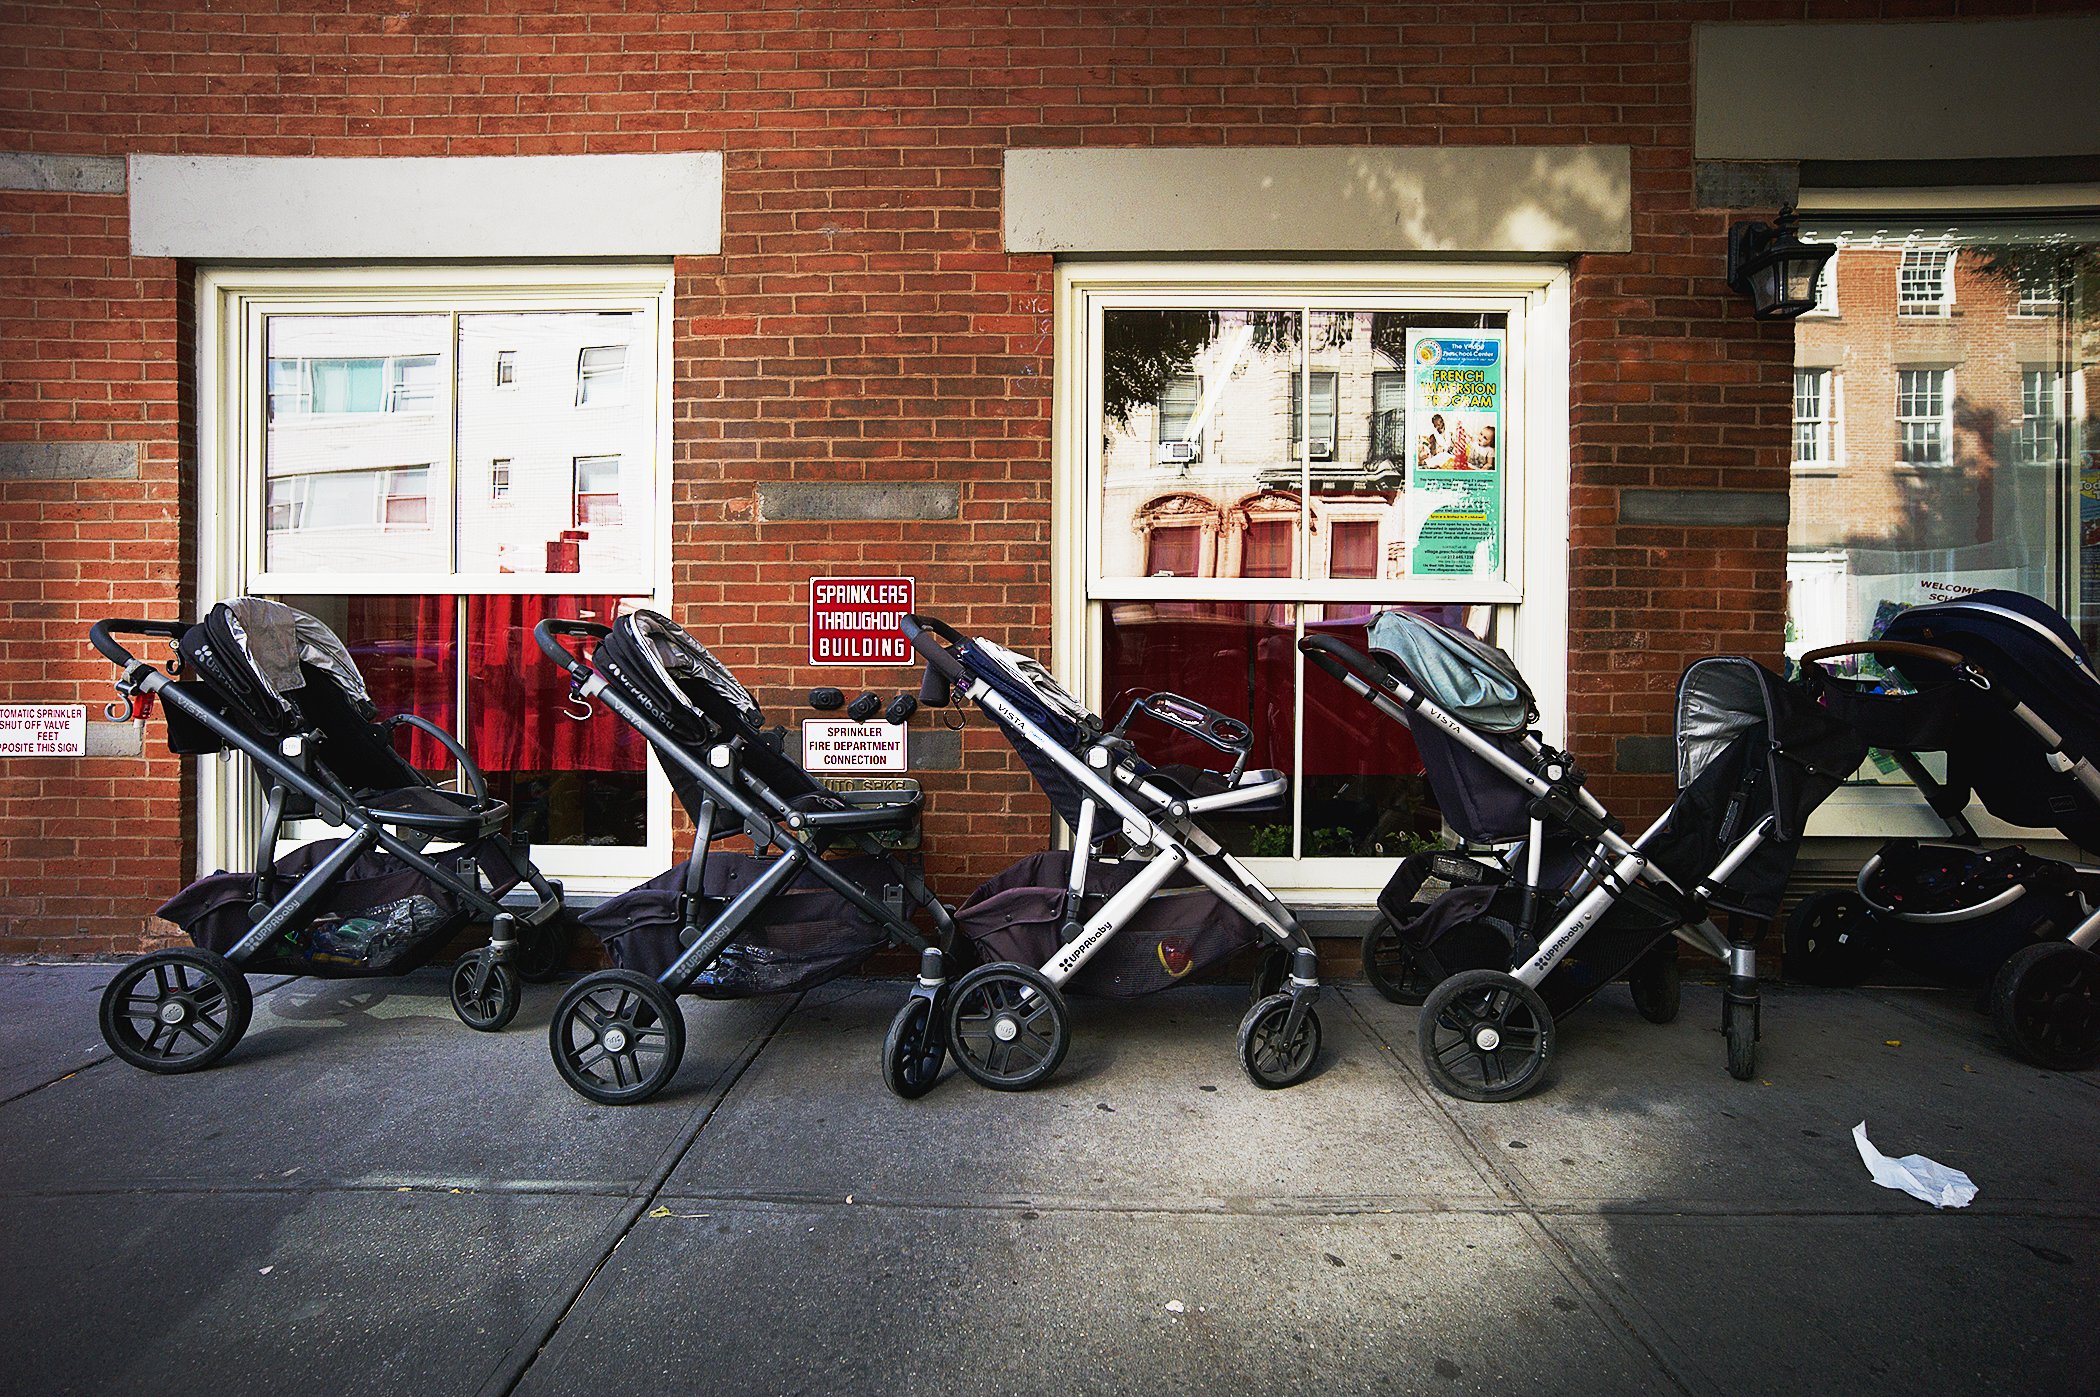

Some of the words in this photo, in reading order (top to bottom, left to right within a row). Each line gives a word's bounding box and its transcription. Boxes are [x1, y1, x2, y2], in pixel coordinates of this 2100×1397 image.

[1018, 297, 1049, 313] NYC
[1433, 370, 1485, 382] FRENCH
[1424, 394, 1493, 408] PROGRAM
[816, 584, 908, 604] SPRINKLERS
[1920, 580, 1980, 594] WELCOME
[819, 638, 905, 657] BUILDING
[36, 709, 82, 719] SPRINKLER
[177, 696, 209, 722] VISTA
[613, 700, 643, 729] VISTA
[998, 703, 1026, 730] VISTA
[1430, 707, 1460, 734] VISTA
[0, 720, 23, 730] SHUT
[24, 720, 42, 730] OFF
[44, 720, 70, 730] VALVE
[827, 727, 882, 737] SPRINKLER
[37, 731, 59, 741] FEET
[0, 743, 34, 752] POSITE
[36, 743, 56, 752] THIS
[57, 743, 78, 753] SIGN
[809, 741, 831, 751] FIRE
[833, 741, 901, 751] DEPARTMENT
[824, 755, 887, 765] CONNECTION
[824, 779, 856, 792] UTO
[254, 899, 300, 941] UPPAbaby
[1068, 921, 1113, 962] UPPAbaby
[1543, 920, 1585, 962] UPPAbaby
